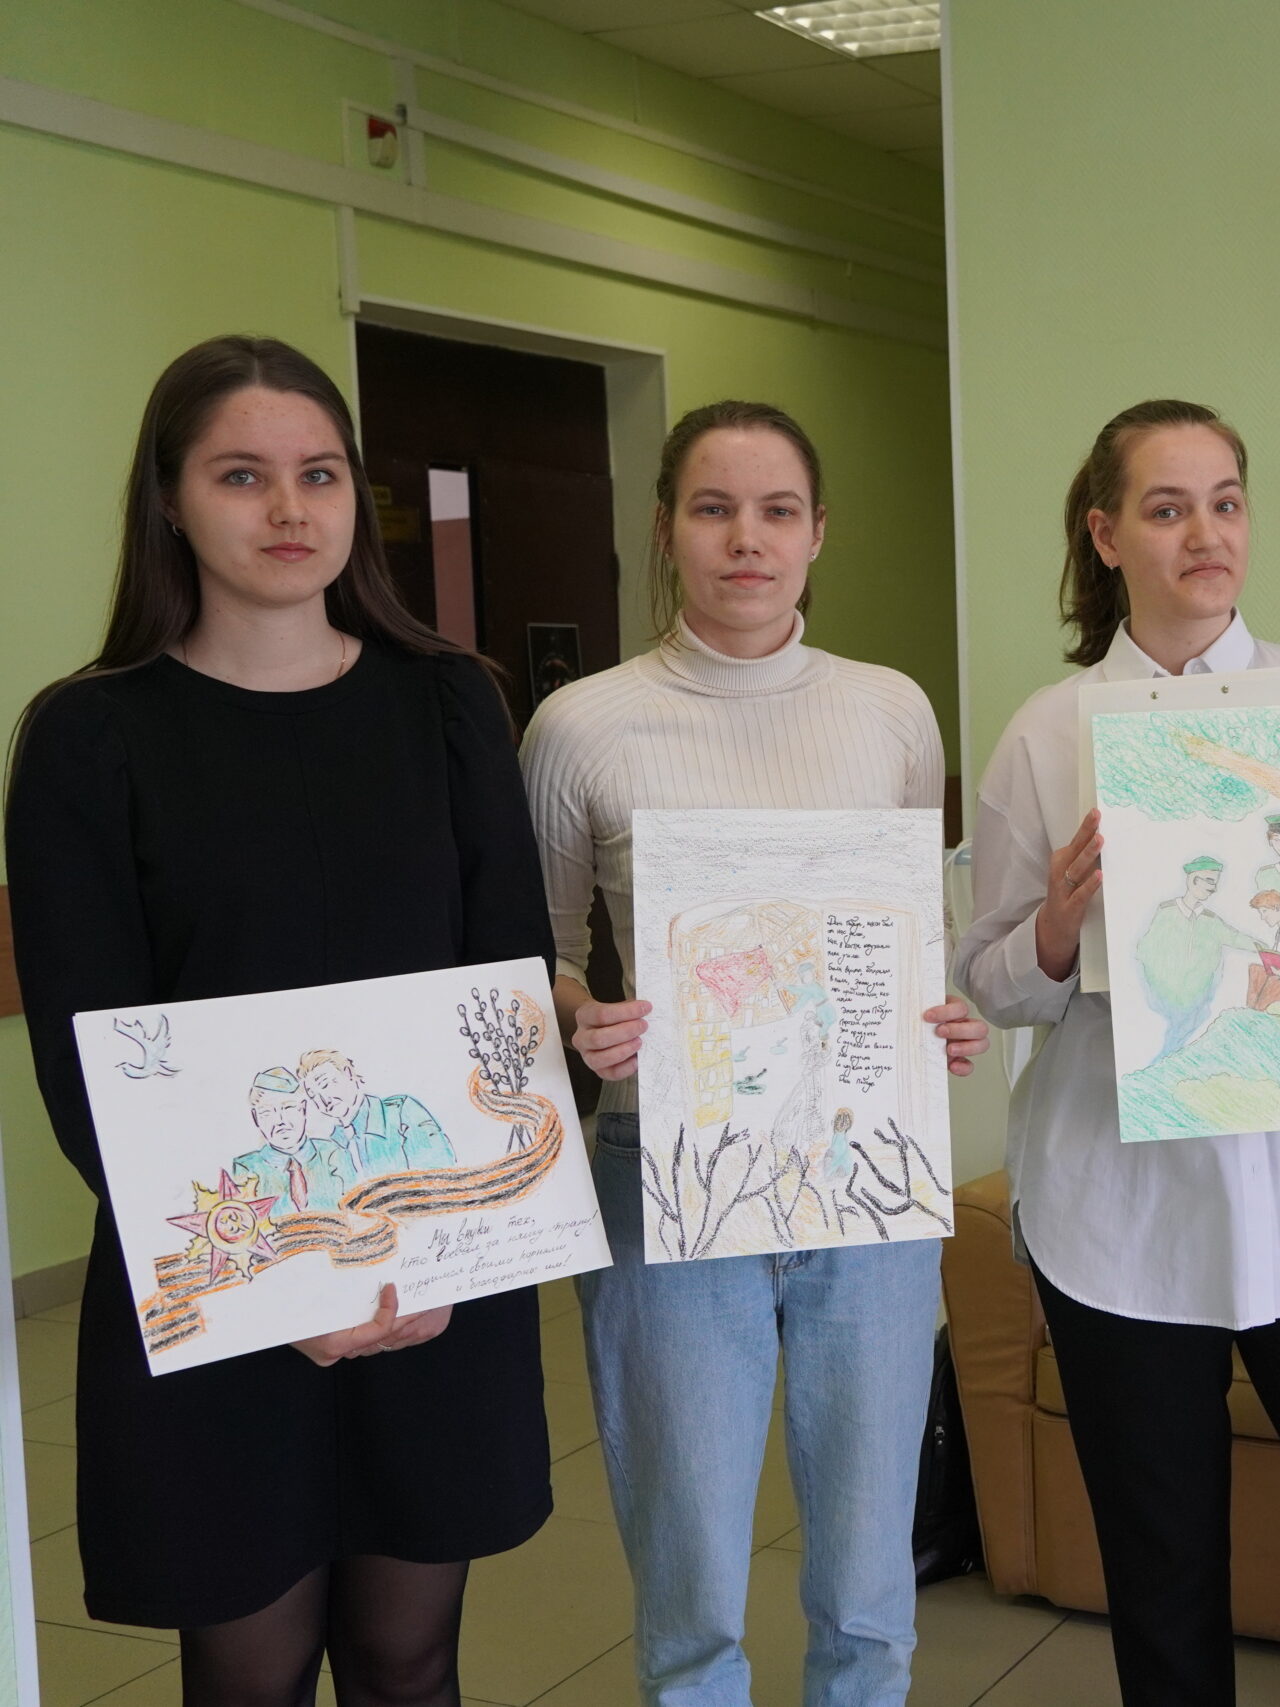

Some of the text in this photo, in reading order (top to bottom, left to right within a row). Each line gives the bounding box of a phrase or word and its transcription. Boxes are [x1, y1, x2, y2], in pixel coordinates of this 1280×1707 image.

[428, 1228, 451, 1249] Мы
[456, 1217, 491, 1246] внуки
[400, 1254, 428, 1270] кто
[485, 1239, 500, 1255] за
